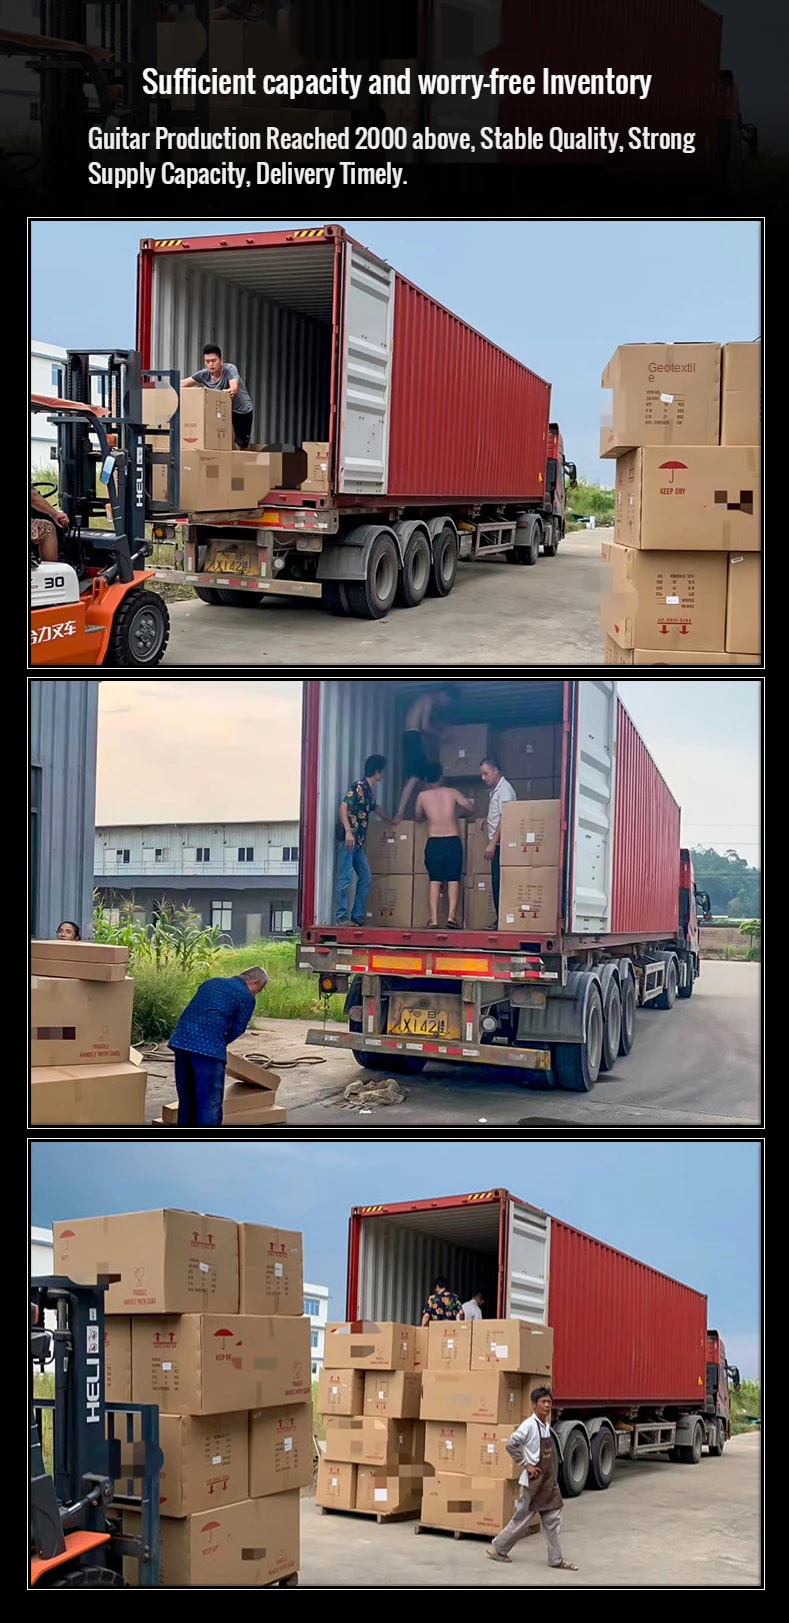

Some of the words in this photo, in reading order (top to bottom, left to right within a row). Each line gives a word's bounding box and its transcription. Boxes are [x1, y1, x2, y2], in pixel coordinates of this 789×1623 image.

[648, 362, 696, 373] Geotextil
[648, 374, 655, 383] e
[44, 576, 65, 589] 30
[86, 1358, 100, 1423] HELI
